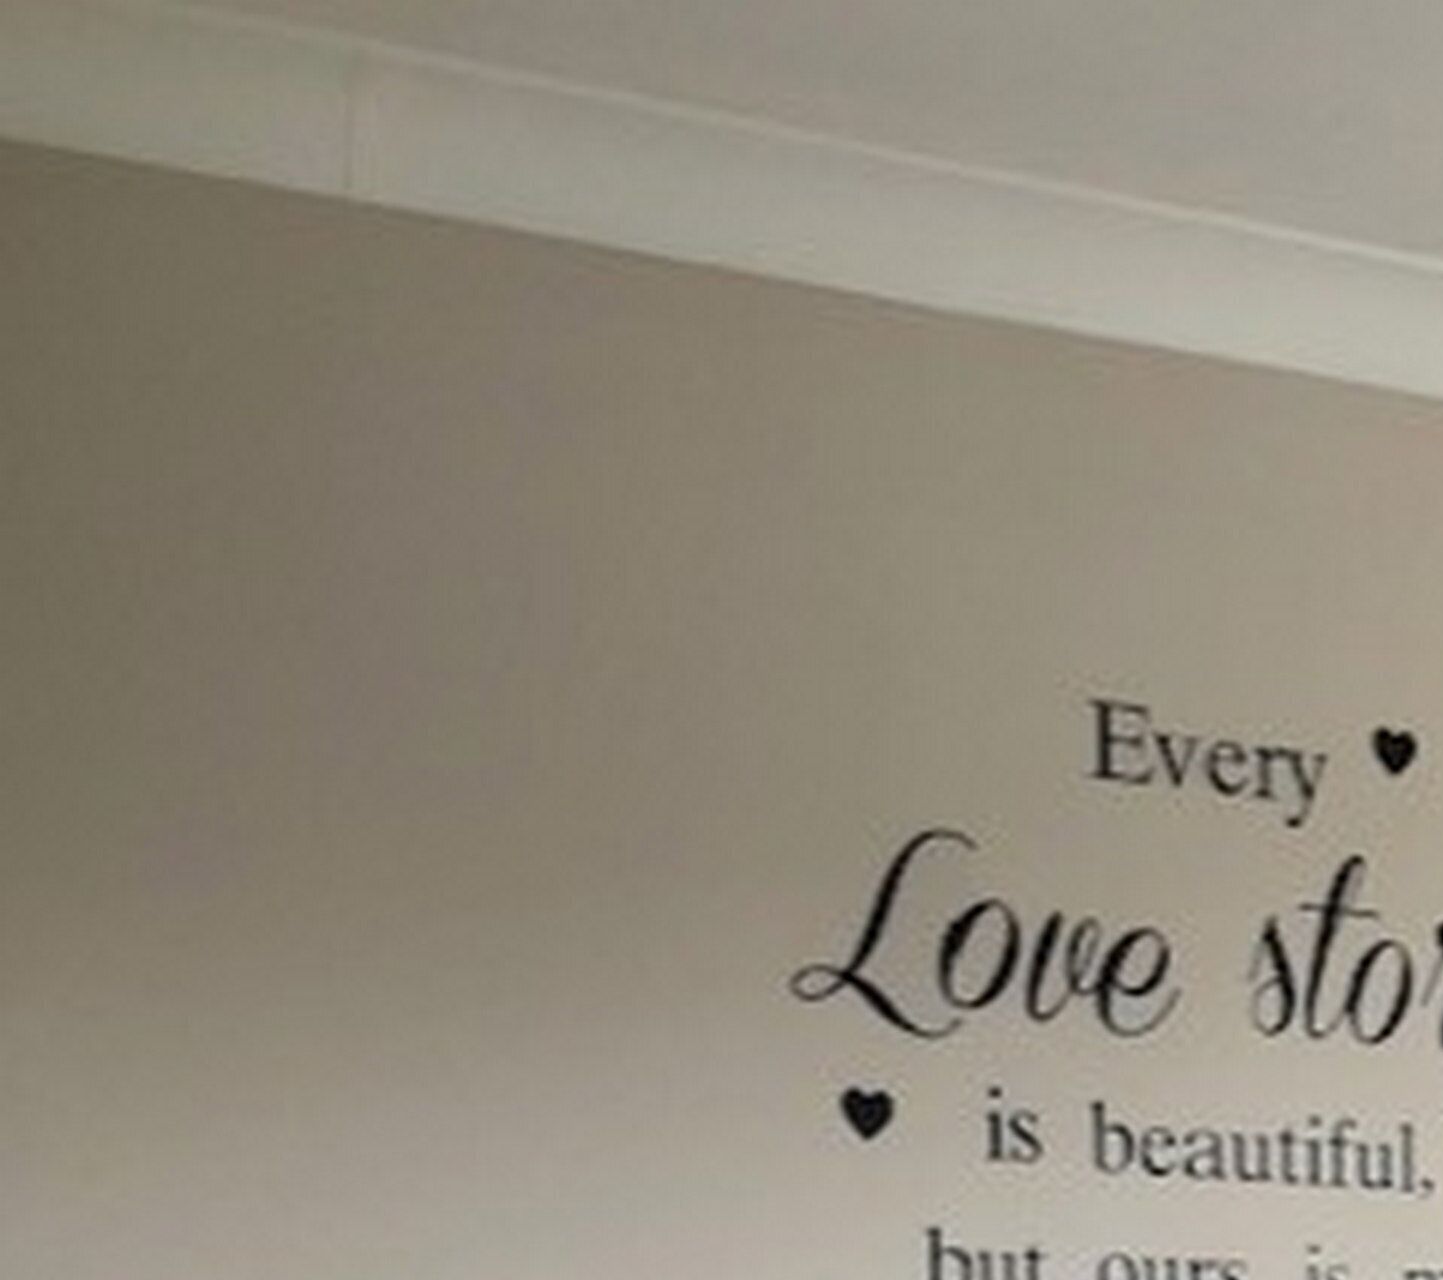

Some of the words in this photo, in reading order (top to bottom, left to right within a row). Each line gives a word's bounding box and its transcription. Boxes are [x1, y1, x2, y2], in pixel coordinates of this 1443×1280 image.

[1088, 698, 1329, 829] Every
[790, 828, 1181, 1040] Love
[985, 1085, 1045, 1164] is
[1089, 1099, 1436, 1196] beautiful,
